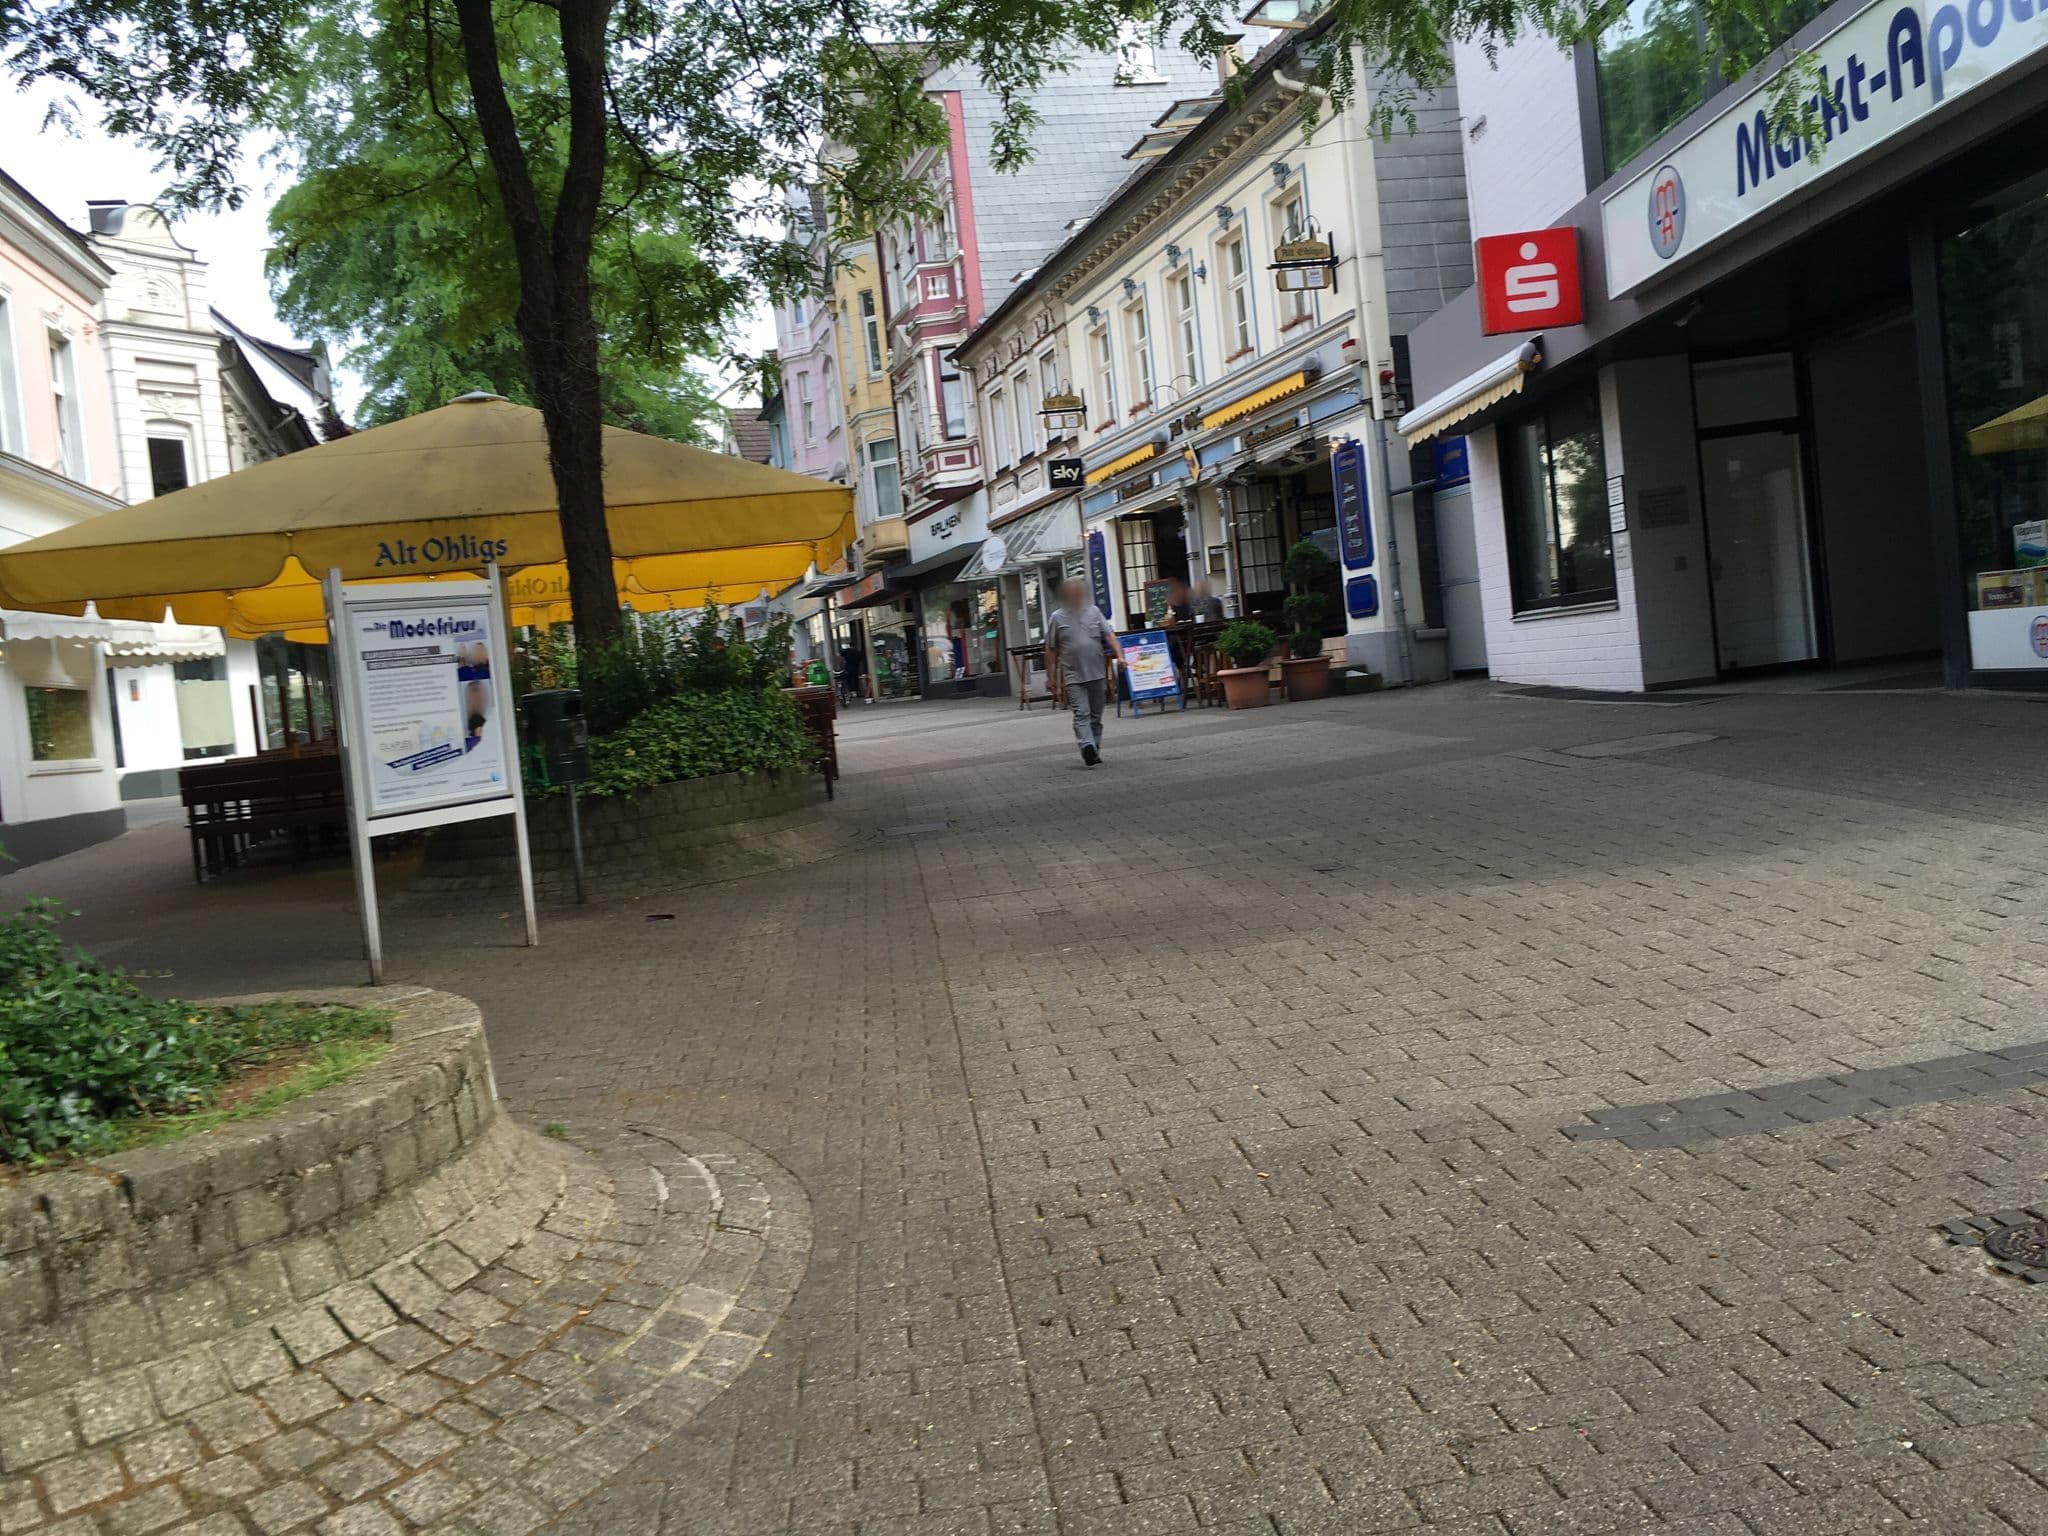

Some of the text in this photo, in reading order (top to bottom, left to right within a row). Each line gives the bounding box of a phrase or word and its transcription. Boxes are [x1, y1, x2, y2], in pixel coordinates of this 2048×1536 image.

[1738, 0, 2048, 197] Markt-Apo
[1052, 465, 1080, 480] sky
[374, 534, 507, 567] Alt Ohligs
[389, 616, 476, 638] Modefrisur
